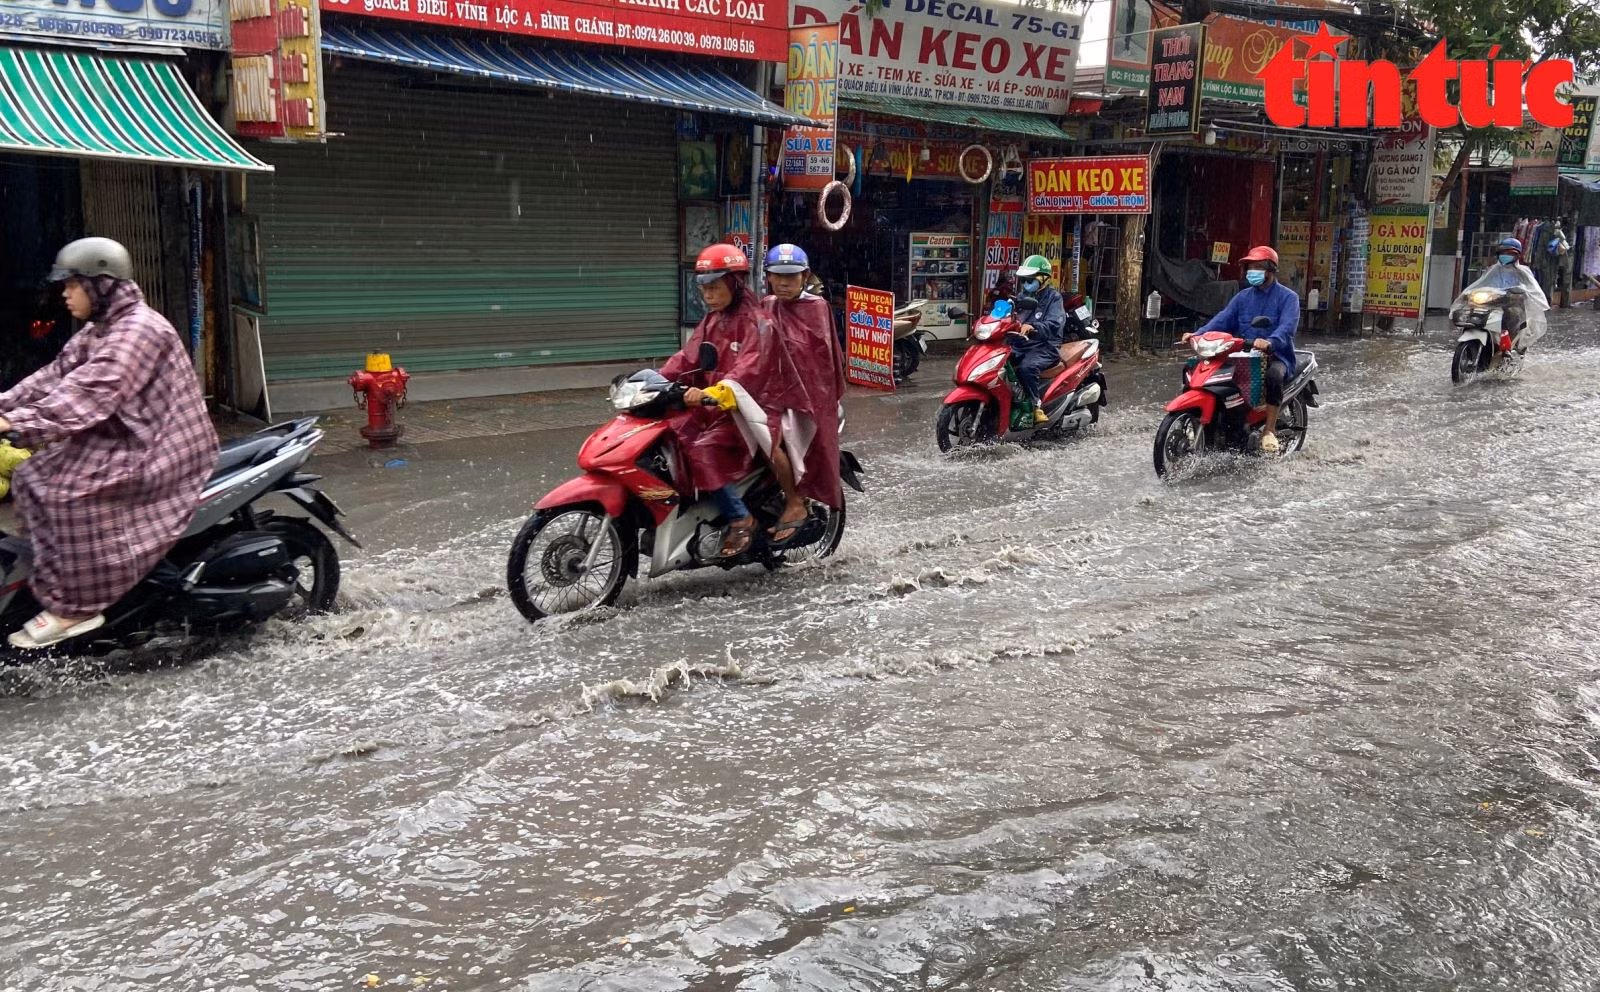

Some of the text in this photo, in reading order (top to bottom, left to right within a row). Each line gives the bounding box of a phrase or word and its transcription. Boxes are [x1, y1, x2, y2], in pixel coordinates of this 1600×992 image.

[726, 0, 766, 24] LOẠI
[906, 0, 1081, 41] DECAL 75-G1
[495, 4, 518, 29] LỘC
[541, 10, 570, 31] BÌNH
[739, 39, 755, 54] 516
[788, 31, 837, 80] DÁN
[917, 26, 1011, 77] KEO
[1016, 40, 1072, 84] XE
[847, 62, 866, 77] XE
[877, 66, 904, 82] TEM
[906, 69, 922, 84] XE
[960, 76, 974, 90] XE
[987, 78, 1001, 93] VÁ
[1003, 80, 1018, 95] ÉP
[1154, 60, 1195, 82] TRANG
[785, 79, 815, 116] KEO
[816, 79, 836, 116] XE
[1158, 86, 1186, 107] NAM
[786, 133, 811, 153] SỬA
[815, 138, 834, 153] XE
[1034, 163, 1145, 193] DÁN KEO XE
[1386, 164, 1400, 175] GÀ
[1053, 195, 1073, 210] ĐỊNH
[1089, 192, 1118, 207] CHỐNG
[1119, 192, 1146, 209] TRỘM
[929, 236, 954, 245] Castrol
[1377, 222, 1398, 239] GÀ
[1007, 246, 1020, 266] XE
[850, 309, 892, 331] SỬA XE
[850, 326, 870, 341] THAY
[851, 340, 870, 358] DÁN
